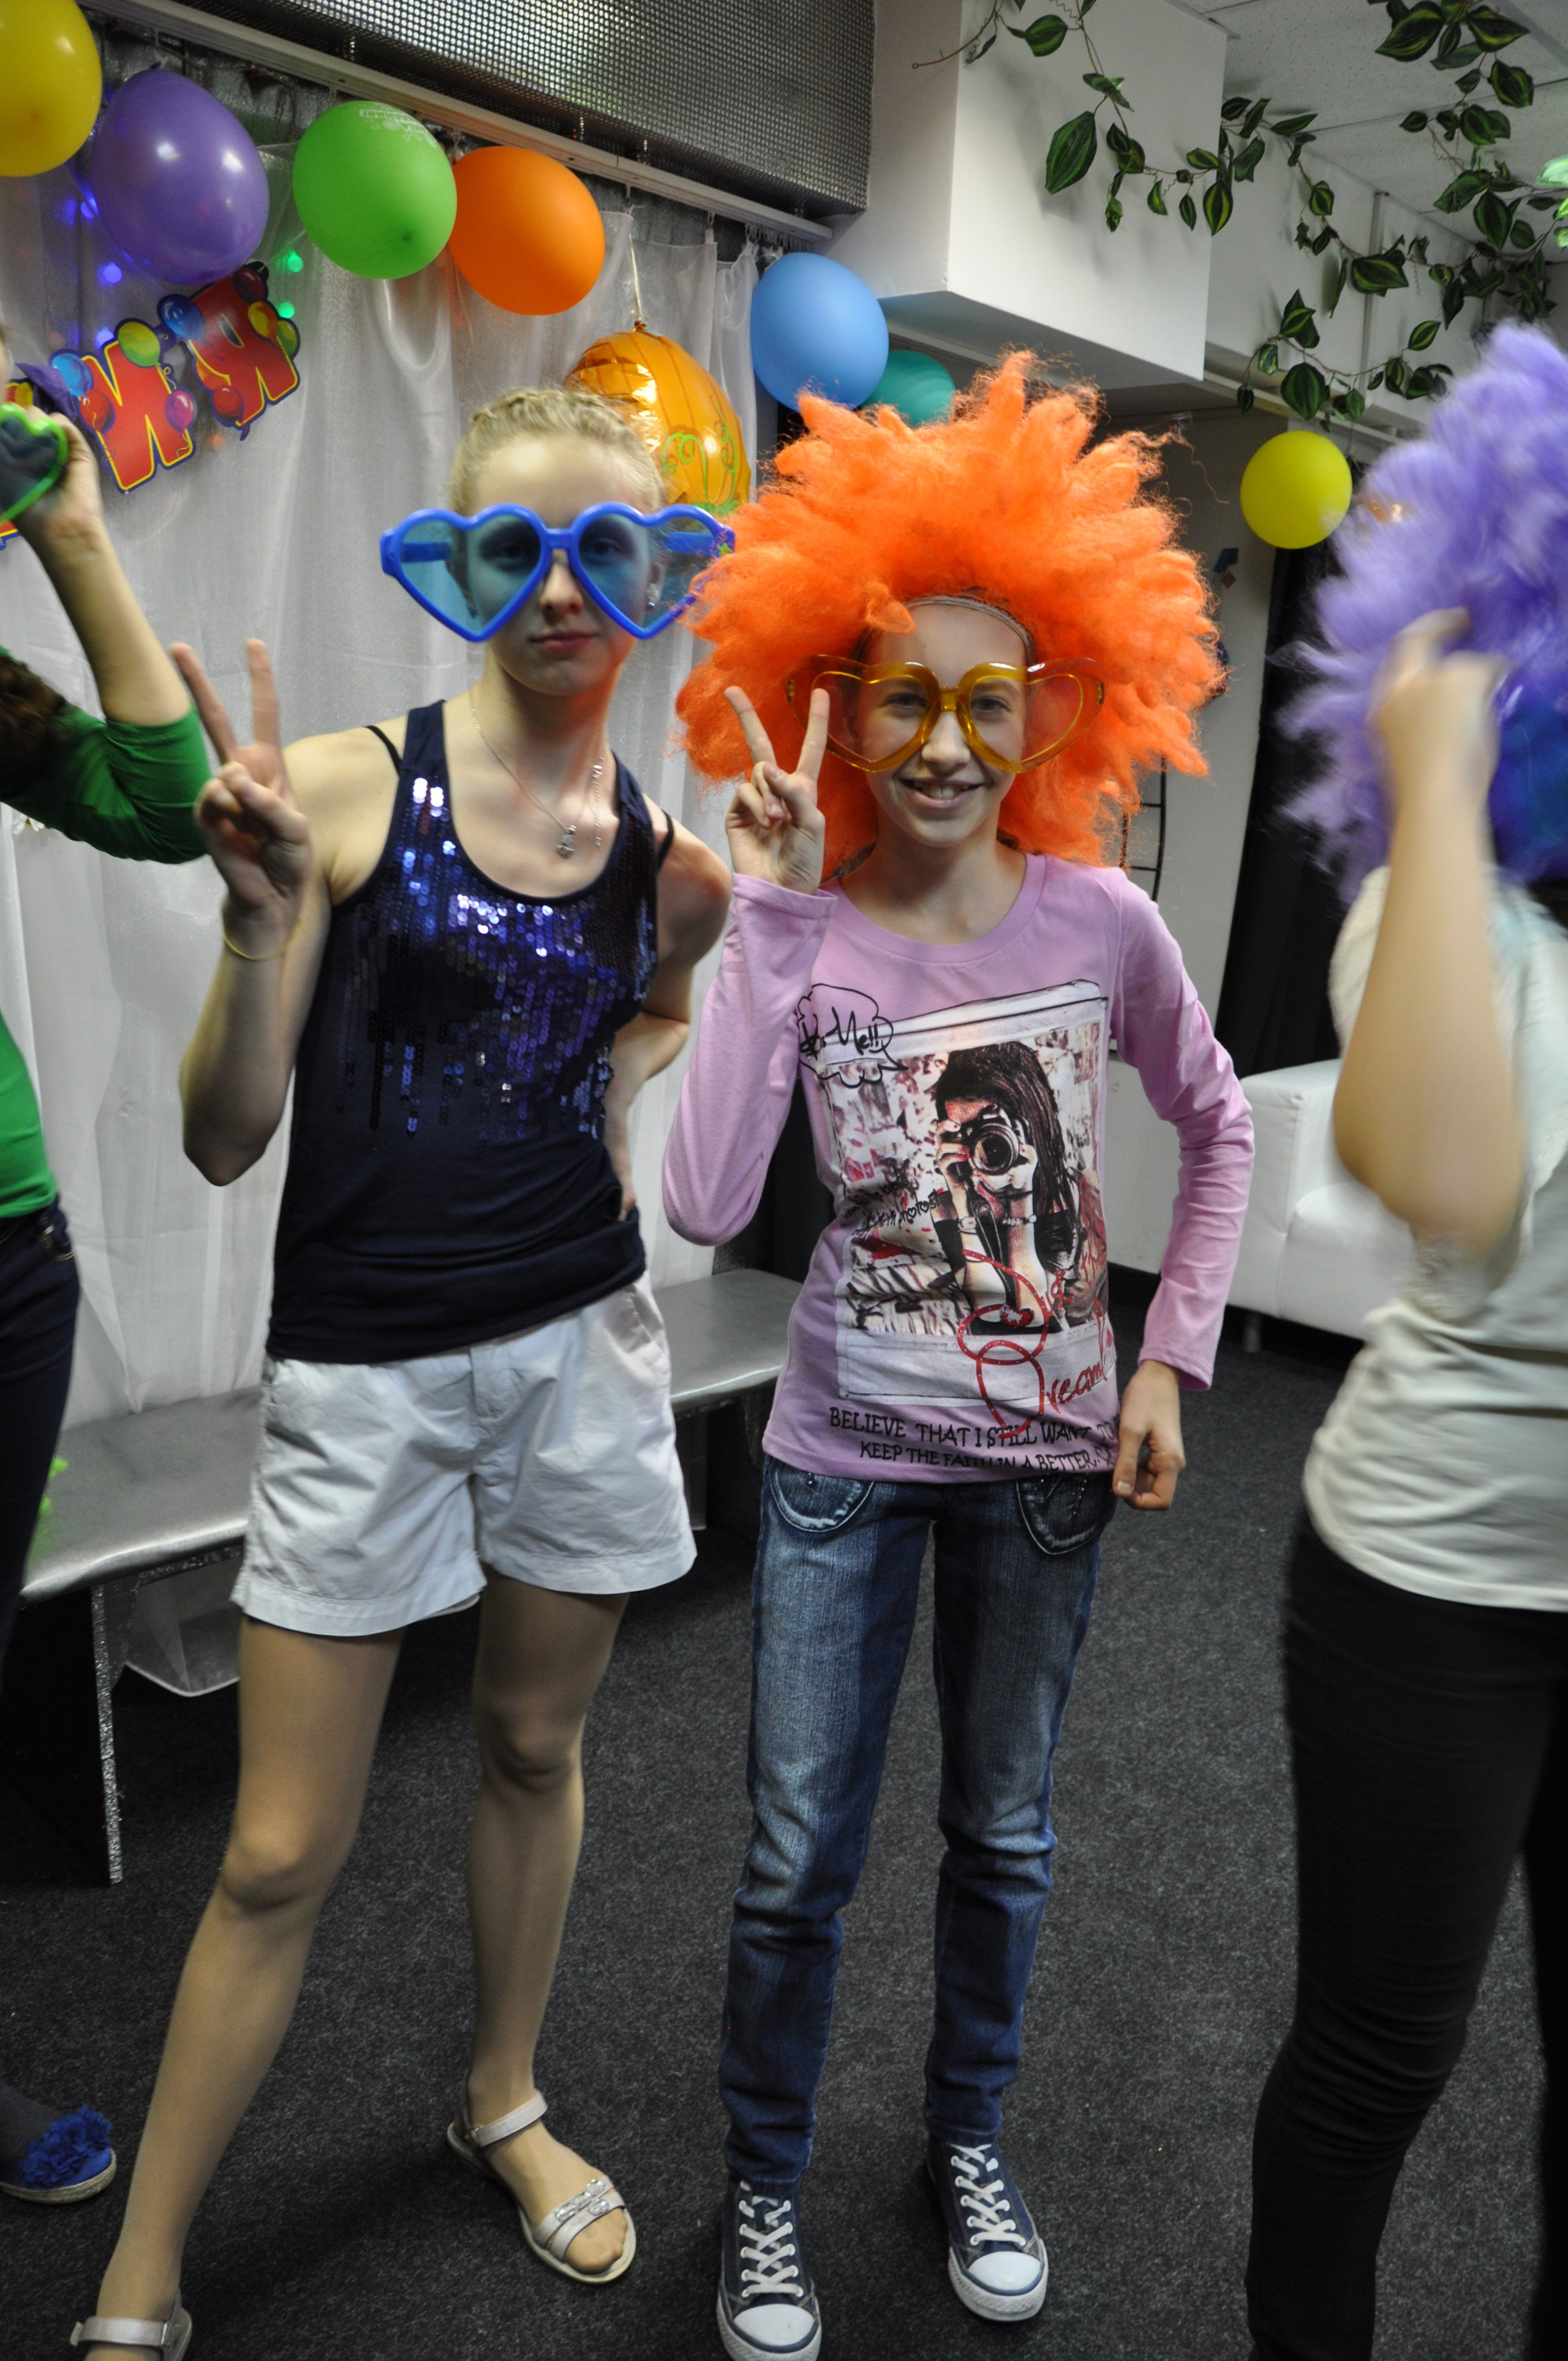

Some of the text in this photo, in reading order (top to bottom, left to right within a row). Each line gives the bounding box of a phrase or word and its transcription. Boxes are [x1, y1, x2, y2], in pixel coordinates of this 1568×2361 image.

[829, 1406, 907, 1438] BELIEVE
[915, 1423, 971, 1447] THAT
[974, 1427, 982, 1448] I
[1039, 1421, 1092, 1444] WANT
[859, 1440, 903, 1461] KEEP
[905, 1447, 940, 1465] THE
[942, 1452, 993, 1467] FAITH
[997, 1455, 1016, 1469] IN
[1021, 1455, 1034, 1469] A
